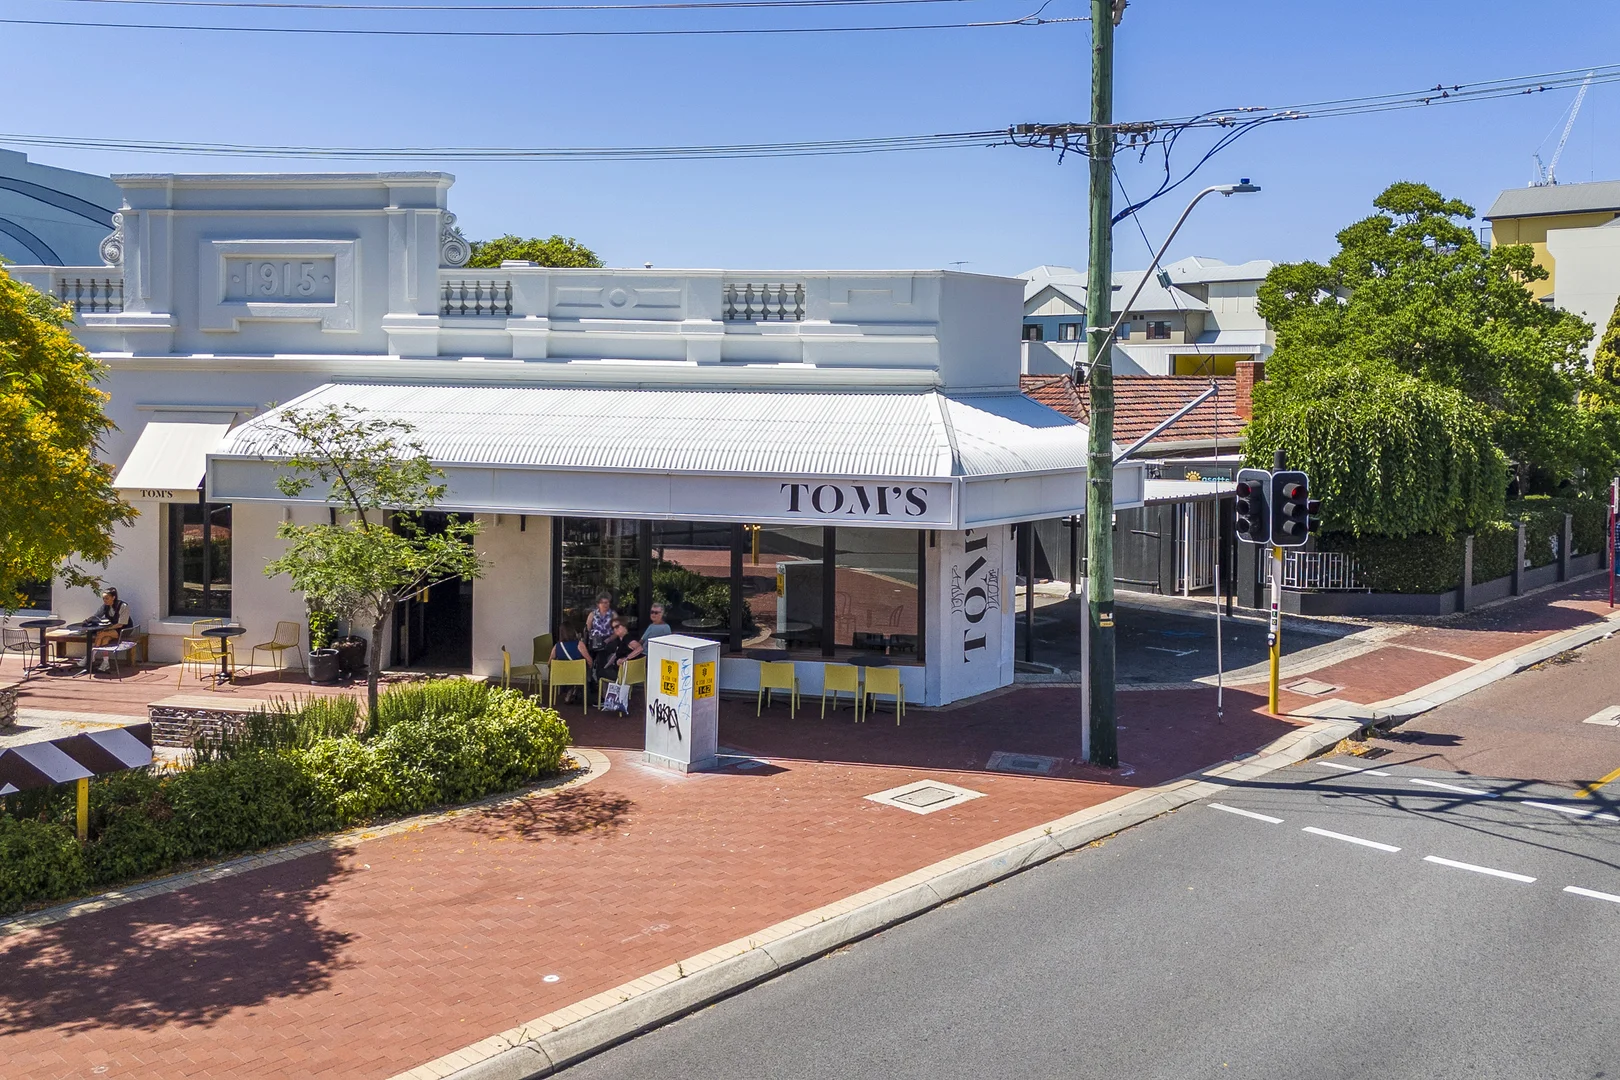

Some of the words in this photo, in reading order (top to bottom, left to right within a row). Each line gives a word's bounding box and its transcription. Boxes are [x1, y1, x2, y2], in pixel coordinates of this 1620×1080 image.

[245, 262, 316, 296] 1915
[140, 489, 173, 498] TOM'S
[780, 483, 928, 516] TOM'S
[664, 682, 675, 692] 142
[699, 685, 711, 695] 142
